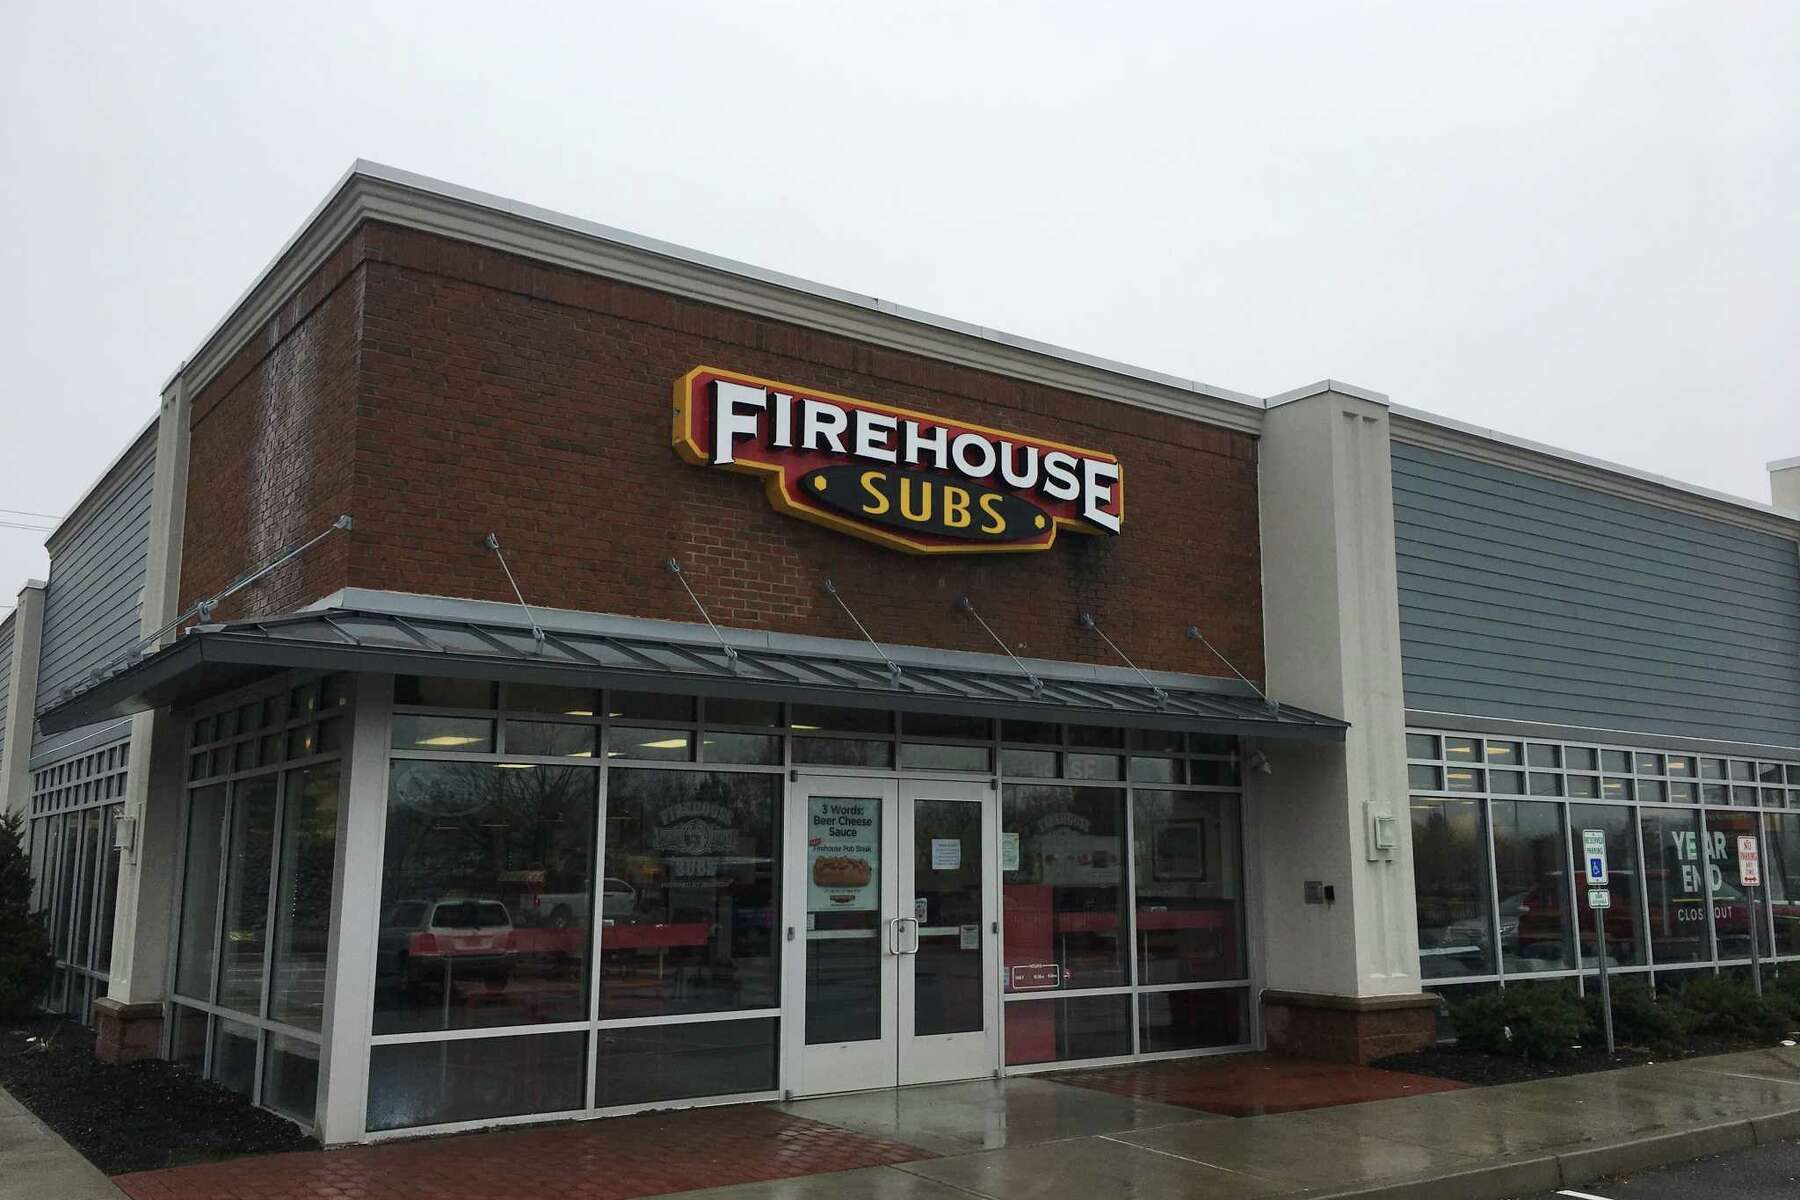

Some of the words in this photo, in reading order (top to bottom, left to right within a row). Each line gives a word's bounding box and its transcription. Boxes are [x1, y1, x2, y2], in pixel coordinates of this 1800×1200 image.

[712, 379, 1120, 535] FIREHOUSE
[859, 470, 1007, 534] SUBS
[822, 804, 828, 815] 3
[831, 805, 864, 815] Words:
[814, 816, 836, 825] Beer
[838, 816, 872, 826] Cheese
[829, 827, 857, 836] Sauce
